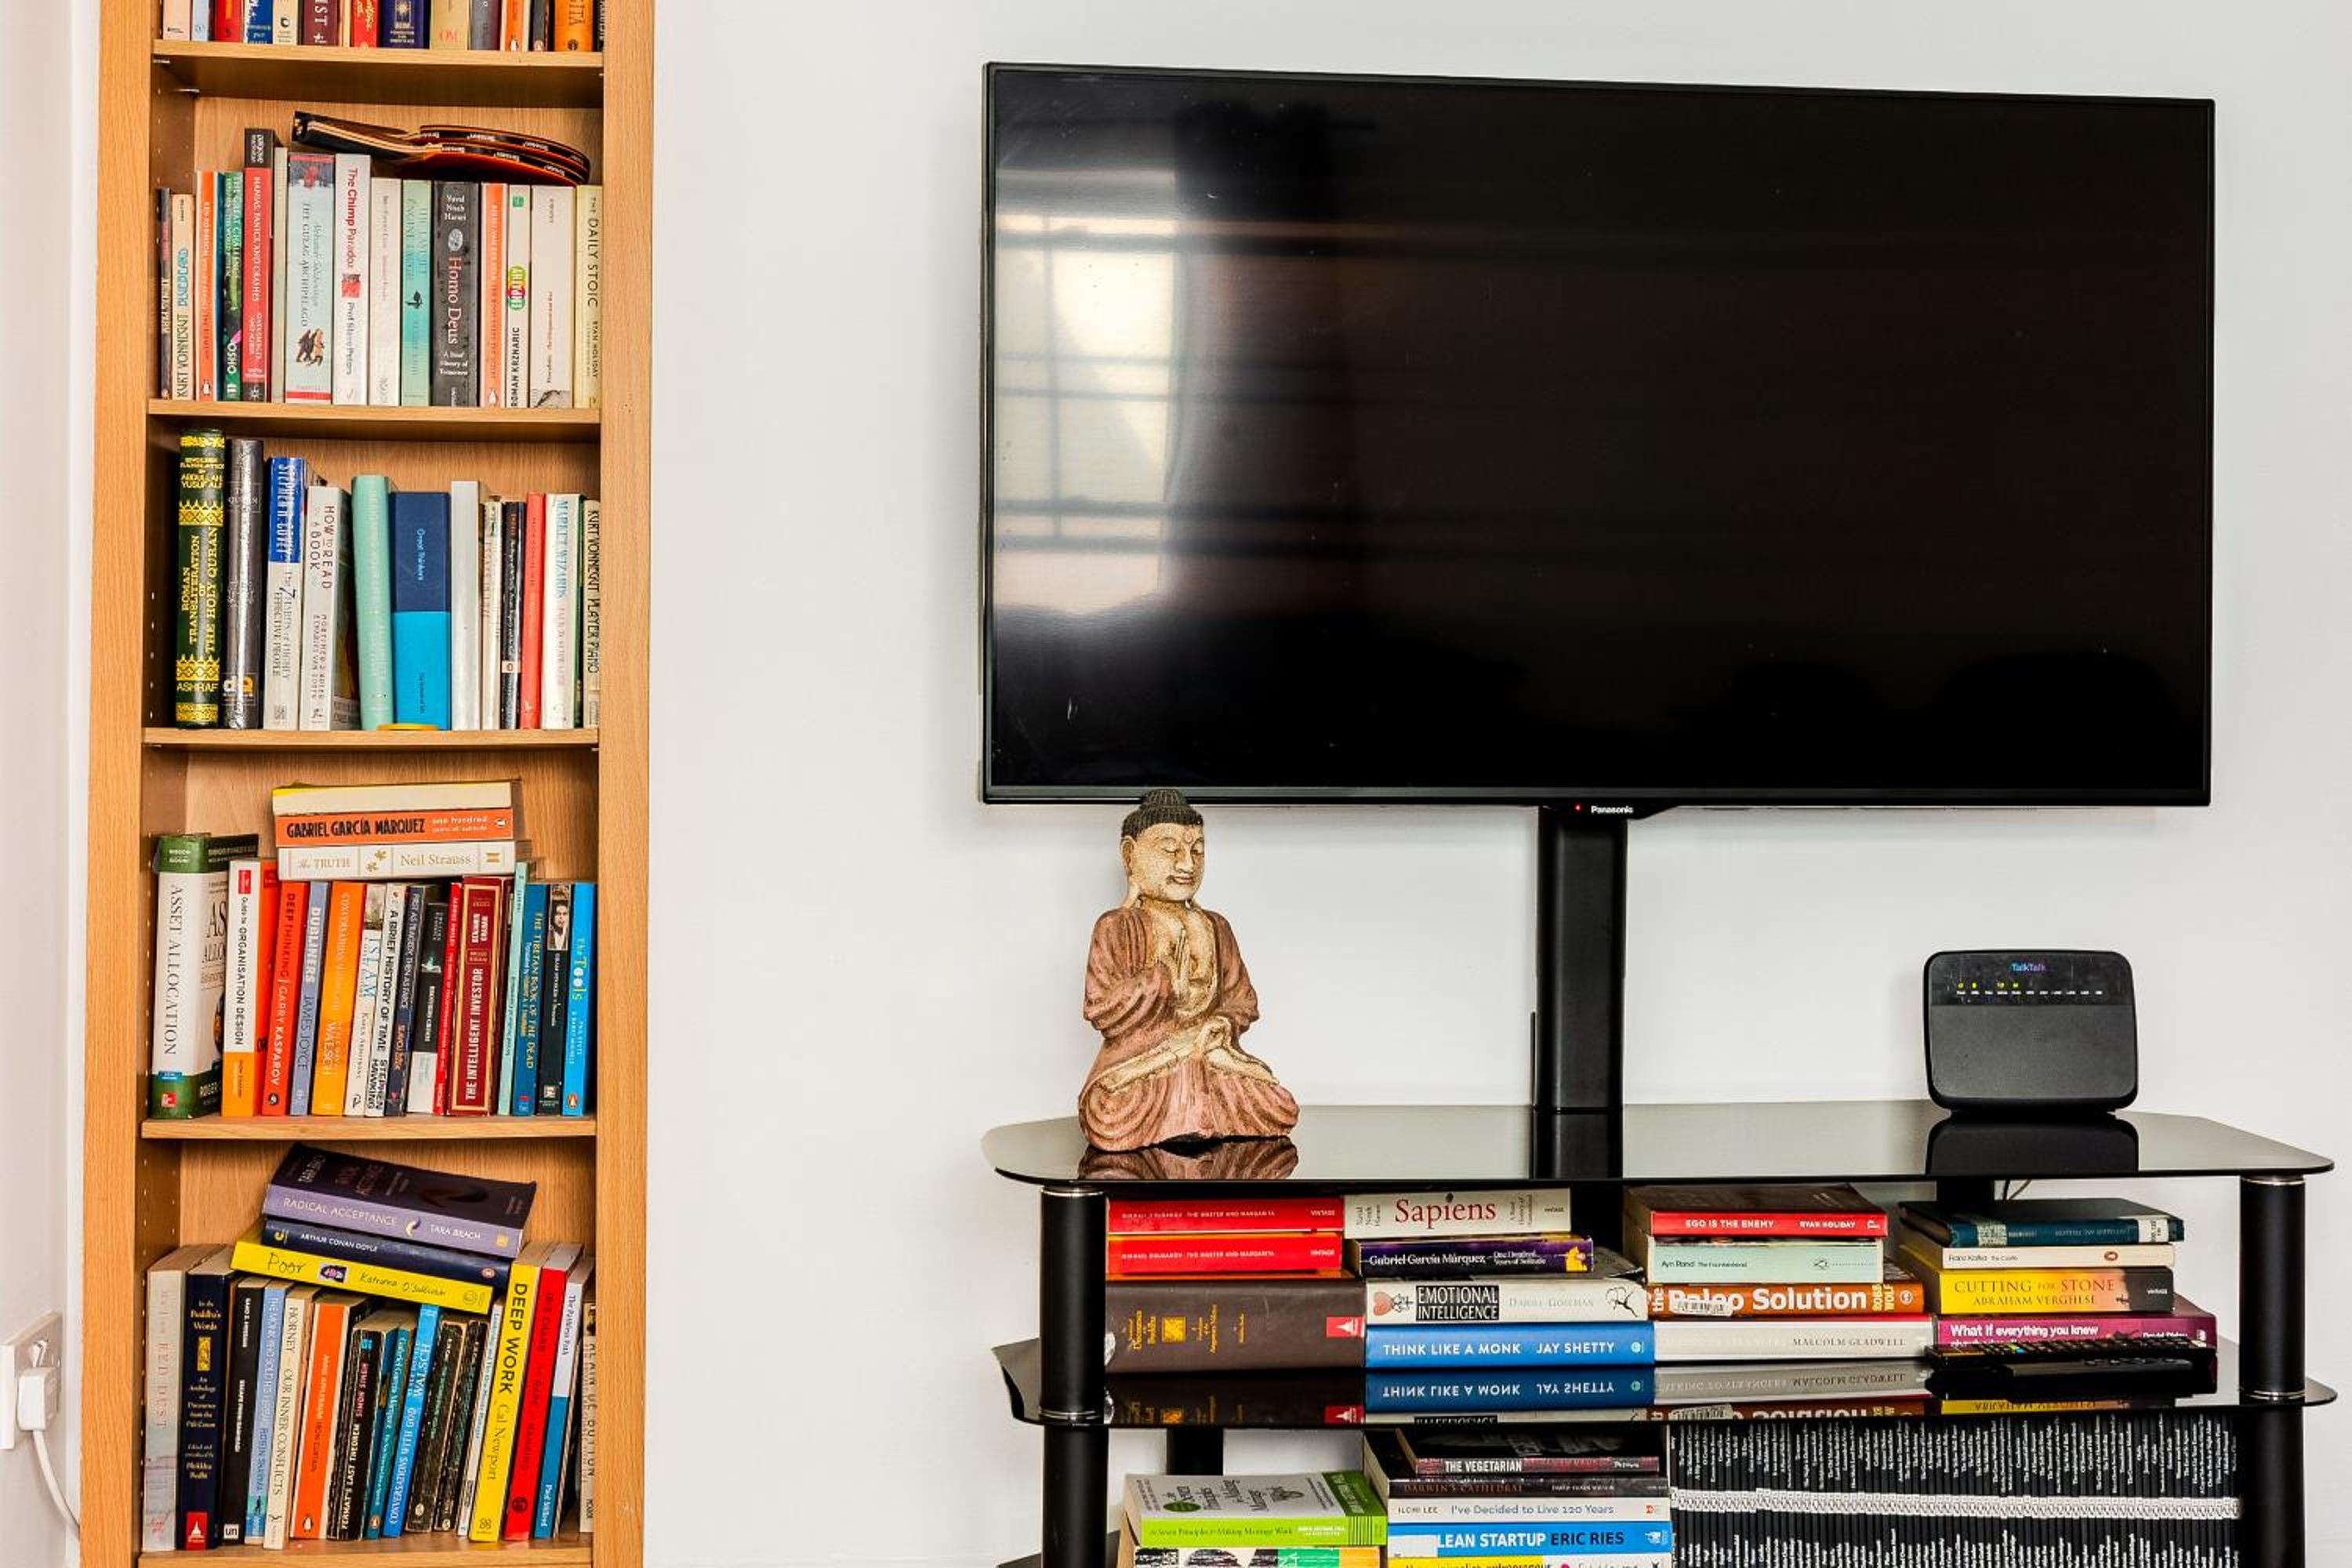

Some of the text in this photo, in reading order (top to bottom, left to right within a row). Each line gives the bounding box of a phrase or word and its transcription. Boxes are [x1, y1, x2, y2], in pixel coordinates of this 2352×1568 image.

[346, 168, 358, 269] The Chimp Paradox
[587, 217, 598, 259] DAILY
[448, 256, 462, 344] Homo Deus
[510, 267, 524, 308] EMPATHY
[587, 263, 598, 308] STOIC
[176, 314, 188, 397] KURT VONNEGUT
[227, 343, 237, 375] OSHO
[510, 328, 521, 407] ROMAN KRZNARIC
[277, 463, 296, 505] STEPHEN
[276, 523, 295, 557] COVEY
[310, 531, 321, 570] BOOK
[321, 506, 335, 589] HOW TO READ
[181, 567, 191, 611] ROMAN
[189, 535, 200, 645] TRANSLITERATION
[198, 583, 206, 597] OF
[205, 526, 219, 652] THE HOLY QURAN
[587, 510, 600, 673] KURT VONNEGUT PLAYER PIANO
[176, 682, 219, 692] ASHRAF
[287, 822, 329, 838] GABRIEL
[331, 816, 371, 837] GARCÍA
[1591, 805, 1634, 815] Panasonic
[314, 858, 350, 869] TRUTH
[401, 851, 471, 866] Neil Strauss
[240, 896, 249, 916] Guide
[163, 884, 183, 1056] ASSET ALLOCATION
[235, 927, 249, 1006] ORGANISATION
[376, 909, 398, 1052] A BRIEF HISTORY OF TIME
[572, 957, 588, 1001] Tools
[2011, 961, 2046, 972] TalkTalk
[270, 893, 296, 1086] DEEP THINKING GARRY KASPAROV
[296, 906, 322, 1071] DUBLINERS JAMES JOYCE
[525, 912, 543, 1069] THE TIBETAN BOOK OF THE DEAD
[234, 1007, 246, 1045] DESIGN
[465, 967, 484, 1101] THE INTELLIGENT INVESTOR
[367, 1058, 379, 1109] HAWKING
[375, 1058, 388, 1111] STEPHEN
[283, 1196, 481, 1240] RADICAL ACCEPTANCE TARA BRACH
[1394, 1197, 1497, 1229] Sapiens
[1685, 1219, 1706, 1229] EGO
[1708, 1219, 1718, 1229] IS
[1721, 1219, 1740, 1229] THE
[1741, 1219, 1775, 1229] ENEMY
[1822, 1220, 1856, 1229] HOLIDAY
[300, 1232, 378, 1252] ARTHUR CONAN DOYLE
[1369, 1254, 1407, 1266] Gabriel
[1661, 1260, 1675, 1269] Ayn
[1418, 1286, 1499, 1305] EMOTIONAL
[1653, 1287, 1664, 1312] the
[1752, 1288, 1867, 1310] Solution
[1882, 1283, 1895, 1312] WOLF
[1954, 1280, 2032, 1294] CUTTING
[2060, 1279, 2115, 1292] STONE
[1973, 1294, 2096, 1306] ABRAHAM VERGHESE
[561, 1294, 577, 1356] The Pathless Path
[1417, 1305, 1498, 1320] INTELLIGENCE
[1950, 1323, 2099, 1340] What if everything you knew
[1383, 1341, 1615, 1356] THINK LIKE A MONK JAY SHETTY
[1793, 1337, 1906, 1347] MALCOLM GLADWELL
[354, 1362, 368, 1417] SIMON SINGH
[412, 1342, 431, 1399] WALSCH
[487, 1283, 529, 1481] DEEP WORK Cal Newport
[272, 1306, 299, 1497] HORNEY OUR INNER CONFLICTS
[341, 1423, 361, 1530] FERMAT'S LAST THEOREM
[388, 1406, 417, 1525] CONVERSATIONS WITH GOD
[1445, 1459, 1523, 1472] THE VEGETARIAN
[1451, 1504, 1614, 1515] I've Decided to Live 120 Years
[1437, 1531, 1625, 1548] LEAN STARTUP ERIC RIES
